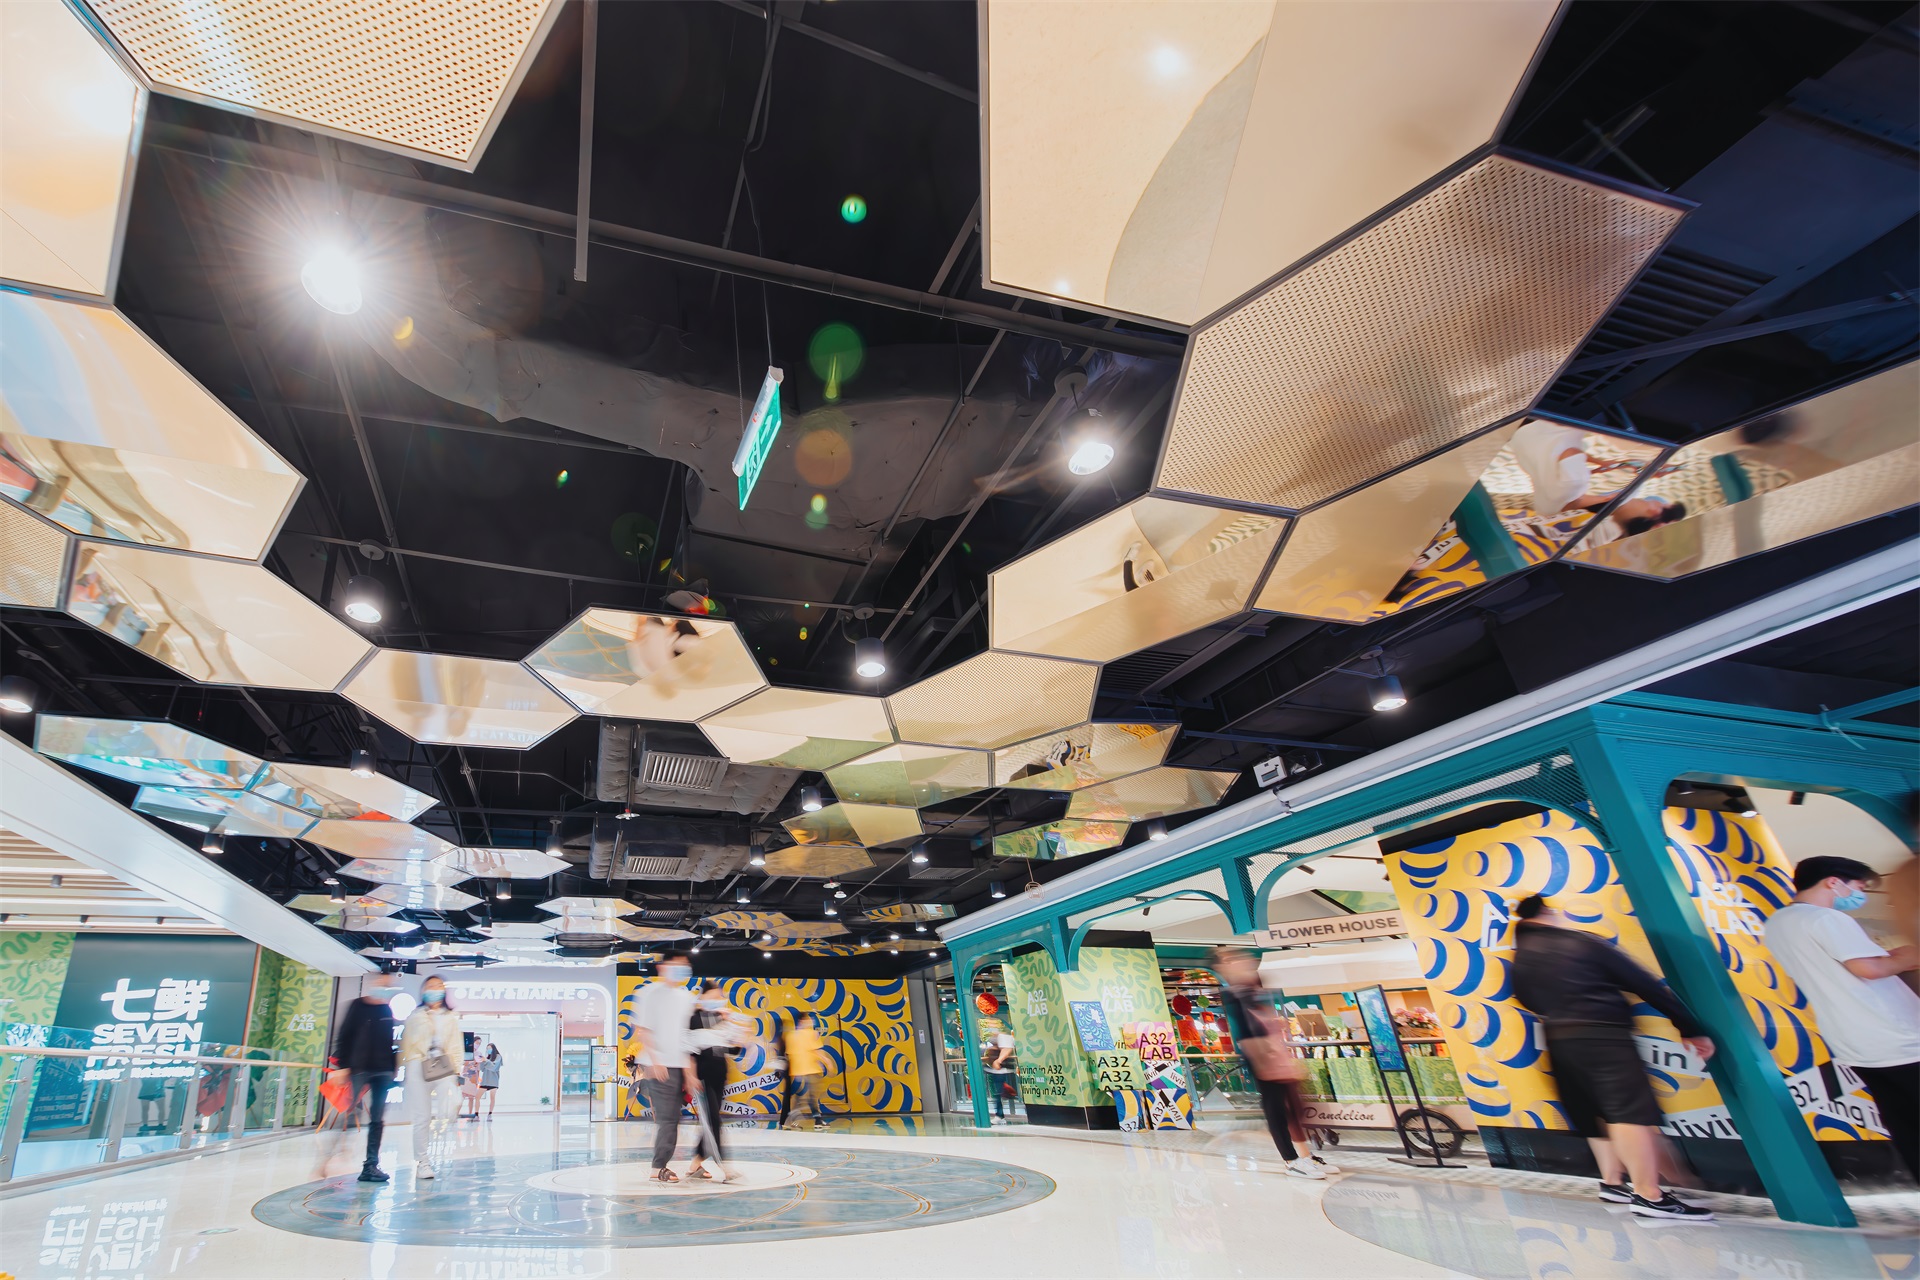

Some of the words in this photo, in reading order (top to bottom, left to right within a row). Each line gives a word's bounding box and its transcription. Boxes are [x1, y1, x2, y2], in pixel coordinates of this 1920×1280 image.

[1695, 881, 1756, 916] A32
[1480, 899, 1523, 936] A3
[1709, 909, 1766, 935] LAB
[1270, 924, 1335, 940] FLOWER
[1339, 917, 1399, 932] HOUSE
[101, 978, 210, 1021] 七鲜
[1027, 989, 1047, 1008] A32
[1102, 985, 1133, 1004] A32
[1029, 1002, 1048, 1017] LAB
[1104, 998, 1134, 1012] LAB
[288, 1013, 316, 1027] A32
[91, 1023, 204, 1044] SEVEN
[1139, 1032, 1171, 1050] A32
[85, 1044, 200, 1067] FRESH
[1098, 1056, 1130, 1067] A32
[1141, 1046, 1173, 1060] LAB
[1652, 1045, 1687, 1069] in
[1047, 1065, 1063, 1074] A32
[1100, 1071, 1132, 1082] A32
[1049, 1076, 1065, 1085] A32
[1050, 1086, 1067, 1096] A32
[1788, 1081, 1819, 1107] 32
[1303, 1106, 1374, 1120] Dandelion
